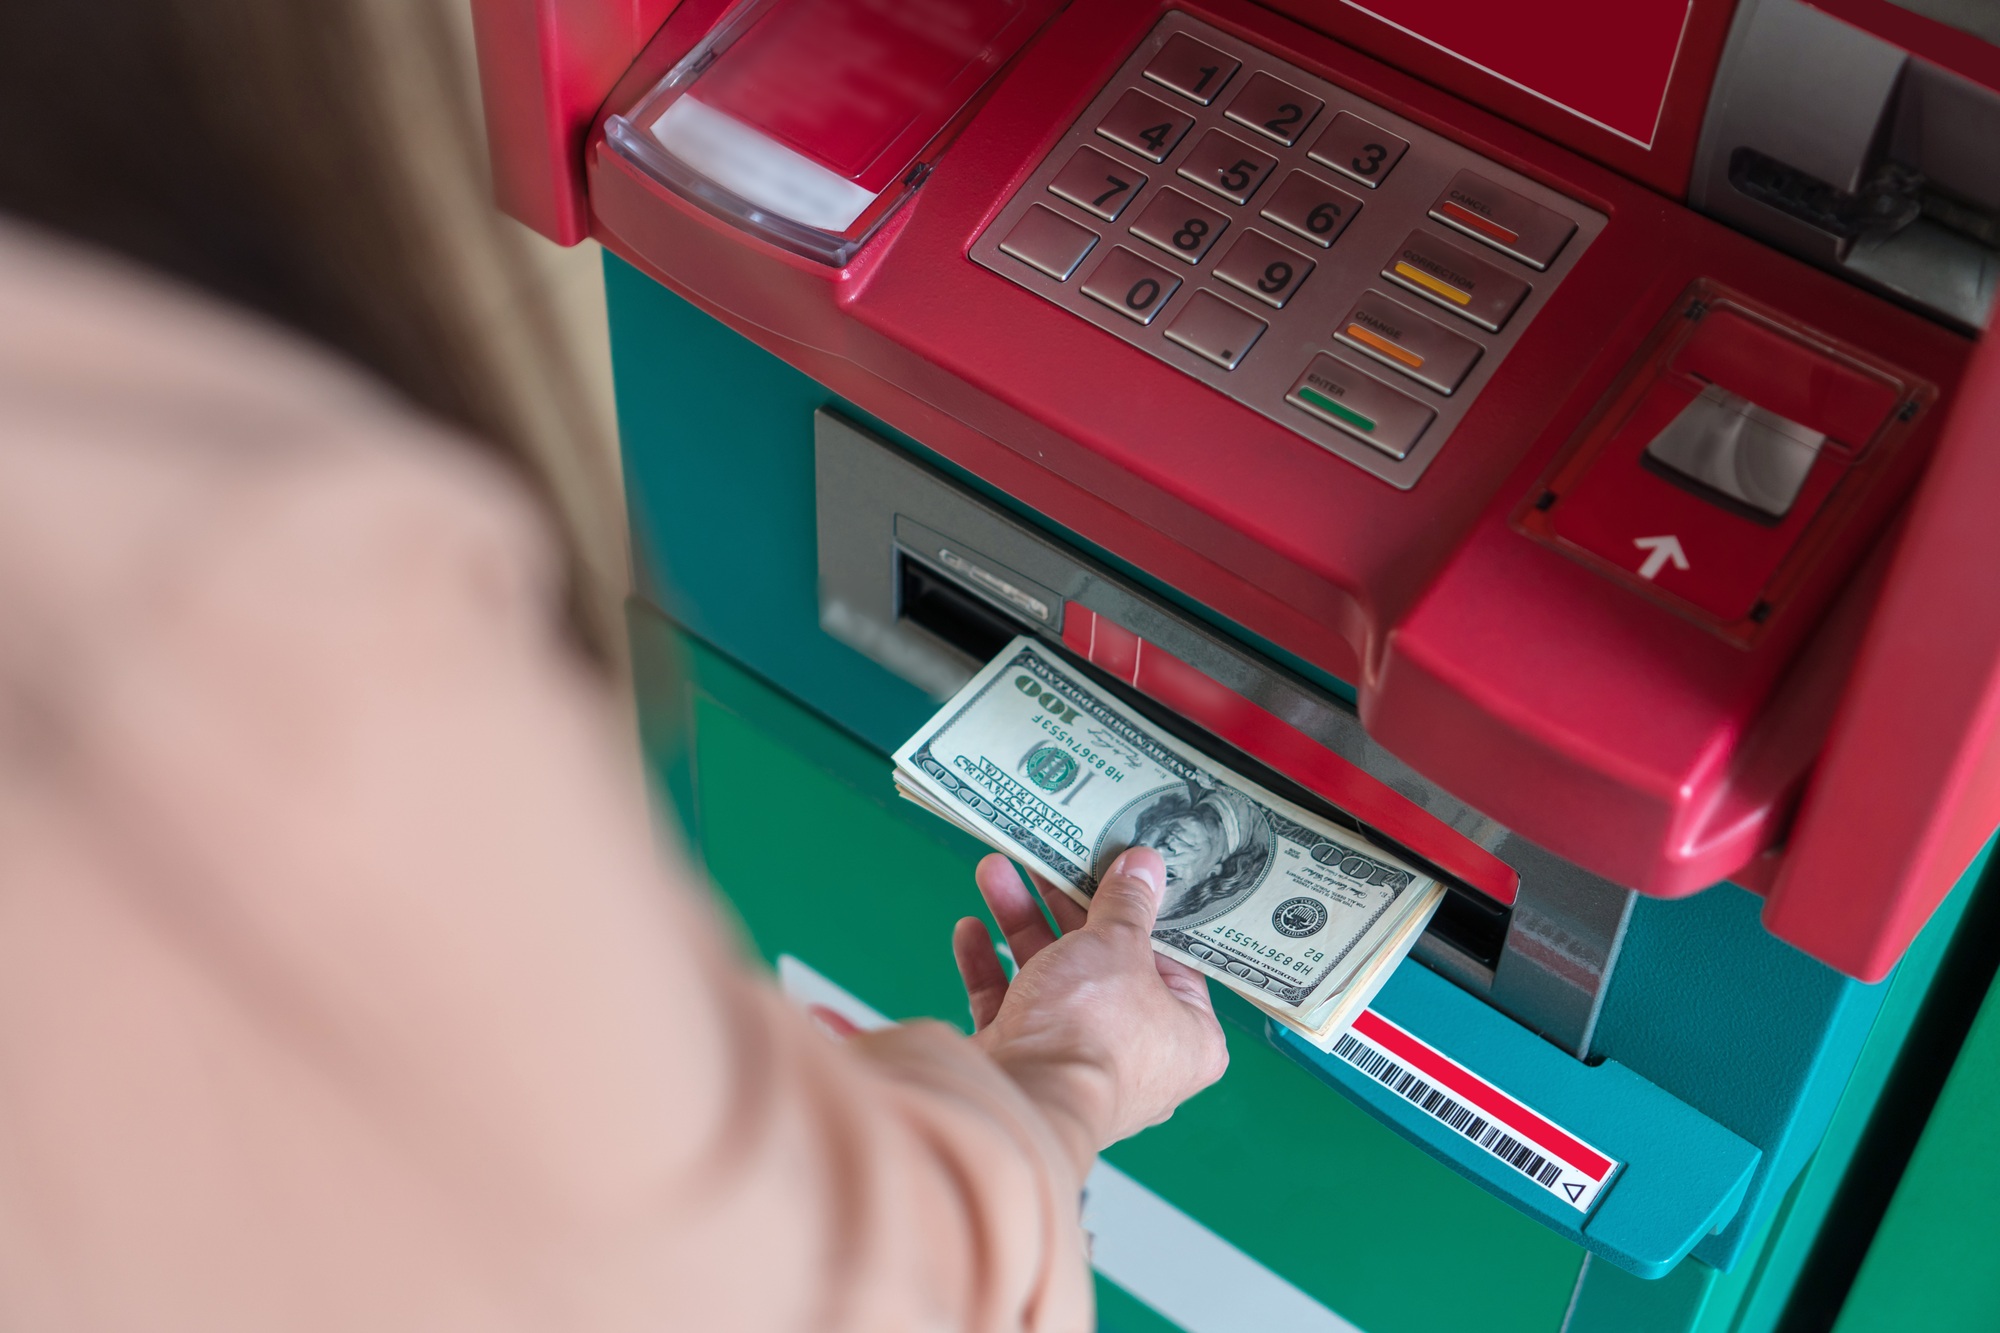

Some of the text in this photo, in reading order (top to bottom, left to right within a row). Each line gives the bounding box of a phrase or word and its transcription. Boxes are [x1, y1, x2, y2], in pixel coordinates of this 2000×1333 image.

[1192, 66, 1220, 93] 1
[1264, 103, 1304, 137] 2
[1139, 121, 1173, 153] 4
[1220, 160, 1260, 192] 5
[1352, 143, 1388, 176] 3
[1092, 175, 1130, 208] 7
[1450, 189, 1494, 217] CANCEL
[1172, 218, 1210, 251] 8
[1306, 202, 1343, 234] 6
[1257, 261, 1294, 294] 9
[1403, 249, 1476, 290] CORRECTION
[1125, 278, 1160, 310] 0
[1355, 311, 1403, 339] CHANGE
[1308, 373, 1345, 398] ENTER
[1025, 656, 1094, 709] DOLLARS
[1014, 674, 1082, 725] 100
[1031, 714, 1043, 723] F
[1092, 704, 1166, 760] HUNDRED
[1041, 719, 1106, 769] 83674553
[953, 754, 1025, 810] STATES
[1104, 765, 1124, 782] HB
[1165, 756, 1197, 781] ONE
[921, 758, 1015, 831] 100
[978, 756, 1062, 822] AMERICA
[1021, 804, 1091, 860] UNITED
[1054, 817, 1083, 838] OF
[1310, 841, 1394, 888] 100
[1191, 929, 1217, 944] NOTE
[1213, 924, 1313, 975] HB 83674553 F
[1188, 941, 1292, 994] 100
[1304, 948, 1324, 962] B2
